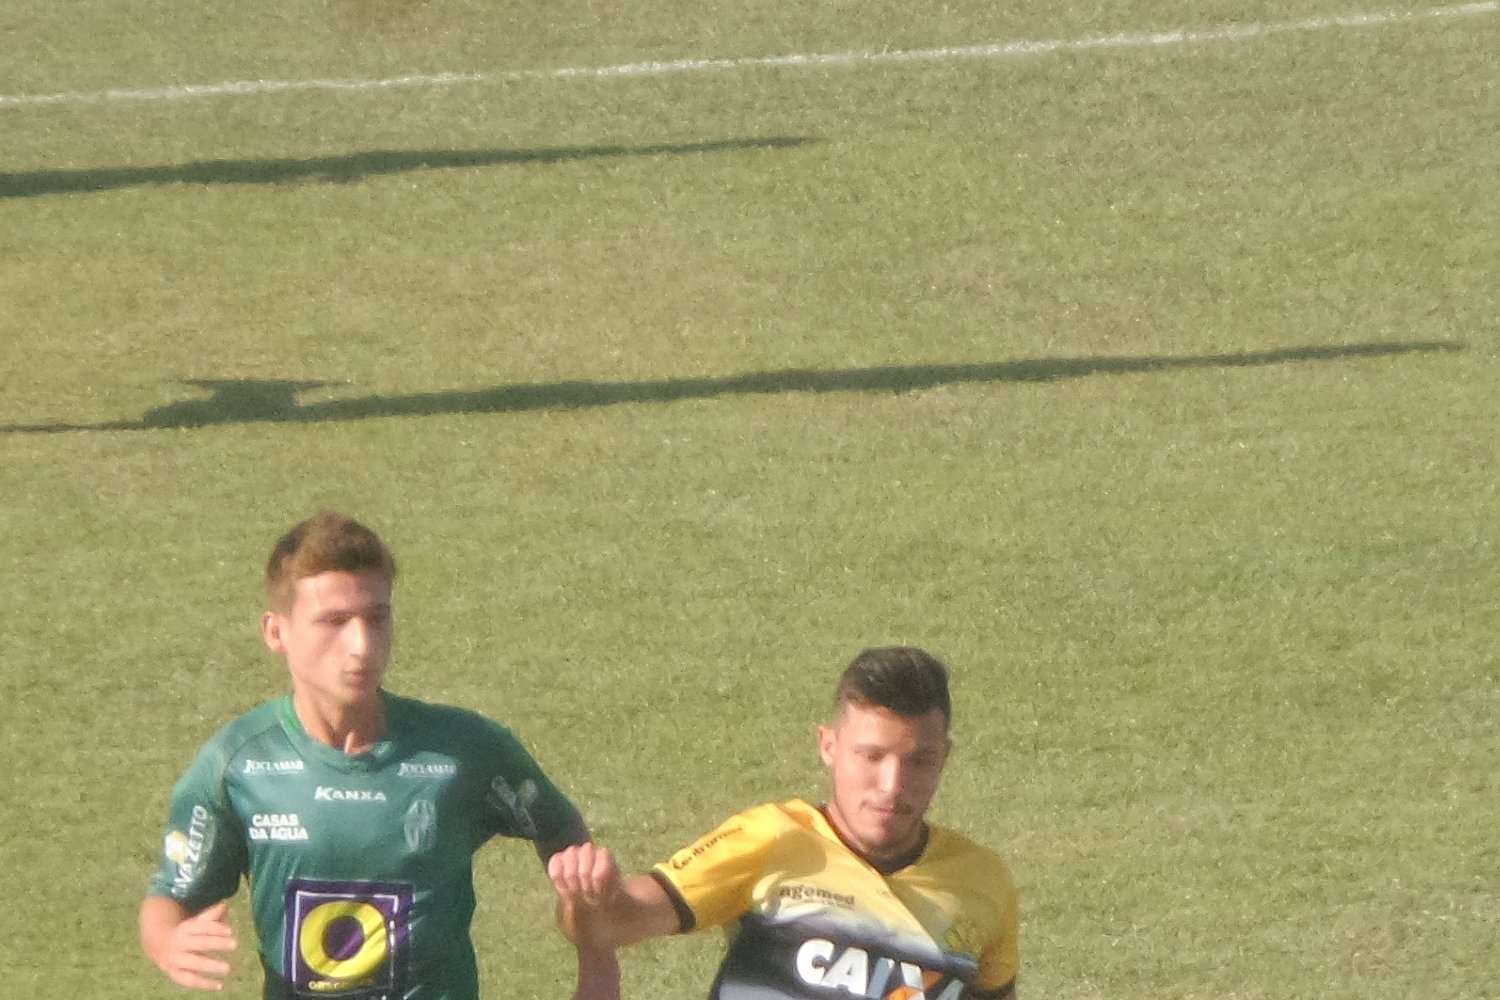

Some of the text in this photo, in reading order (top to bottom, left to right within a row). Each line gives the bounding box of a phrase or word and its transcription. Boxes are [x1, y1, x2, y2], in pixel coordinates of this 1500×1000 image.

[314, 785, 387, 801] KANXA
[252, 813, 299, 827] CASAS
[249, 827, 269, 840] DA
